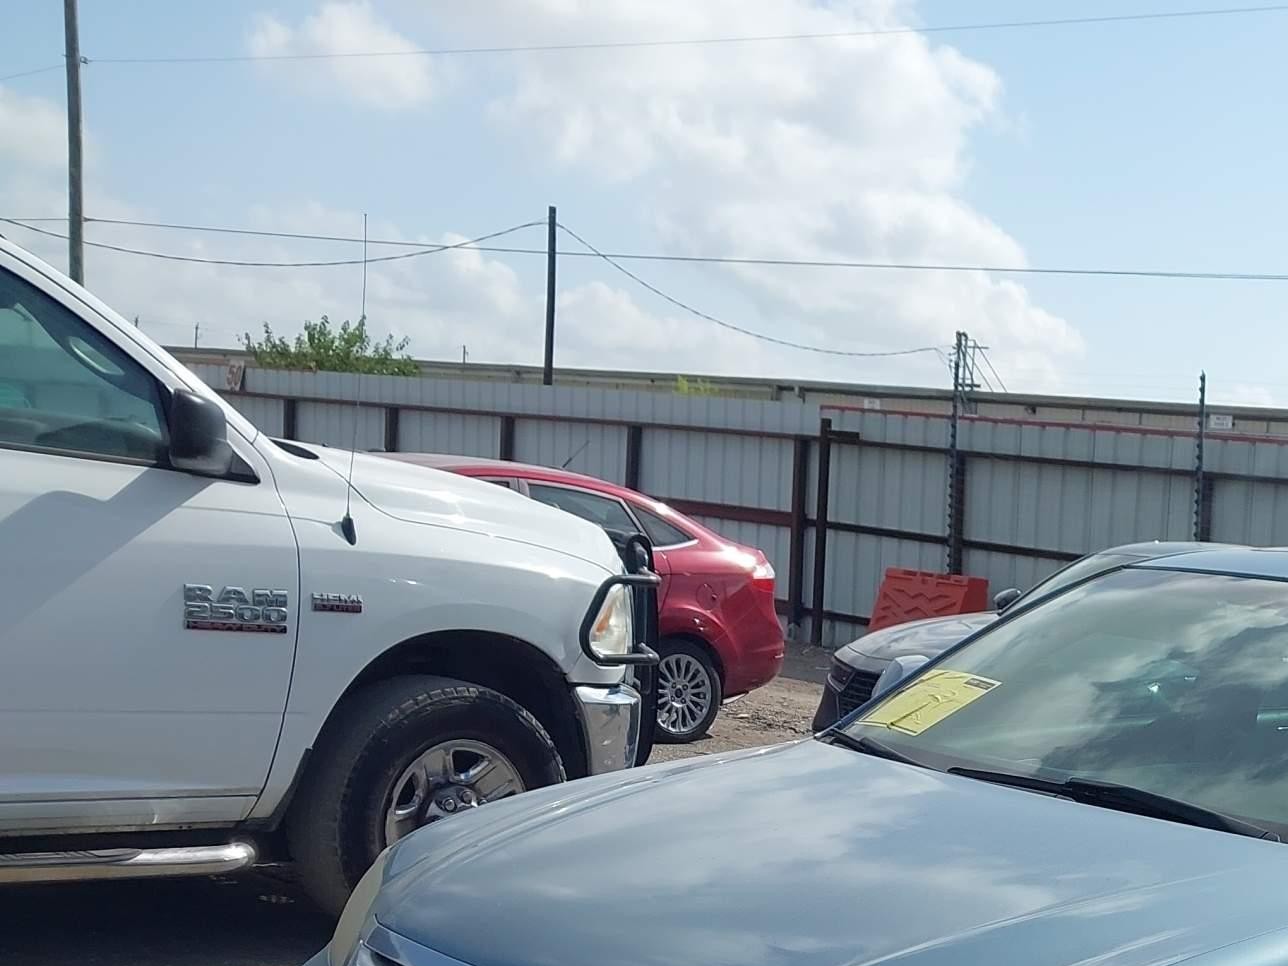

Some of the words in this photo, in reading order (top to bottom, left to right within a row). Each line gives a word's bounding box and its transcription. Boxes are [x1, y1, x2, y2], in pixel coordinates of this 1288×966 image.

[184, 583, 288, 607] RAM
[312, 592, 363, 604] HEMI
[184, 601, 288, 623] 2500
